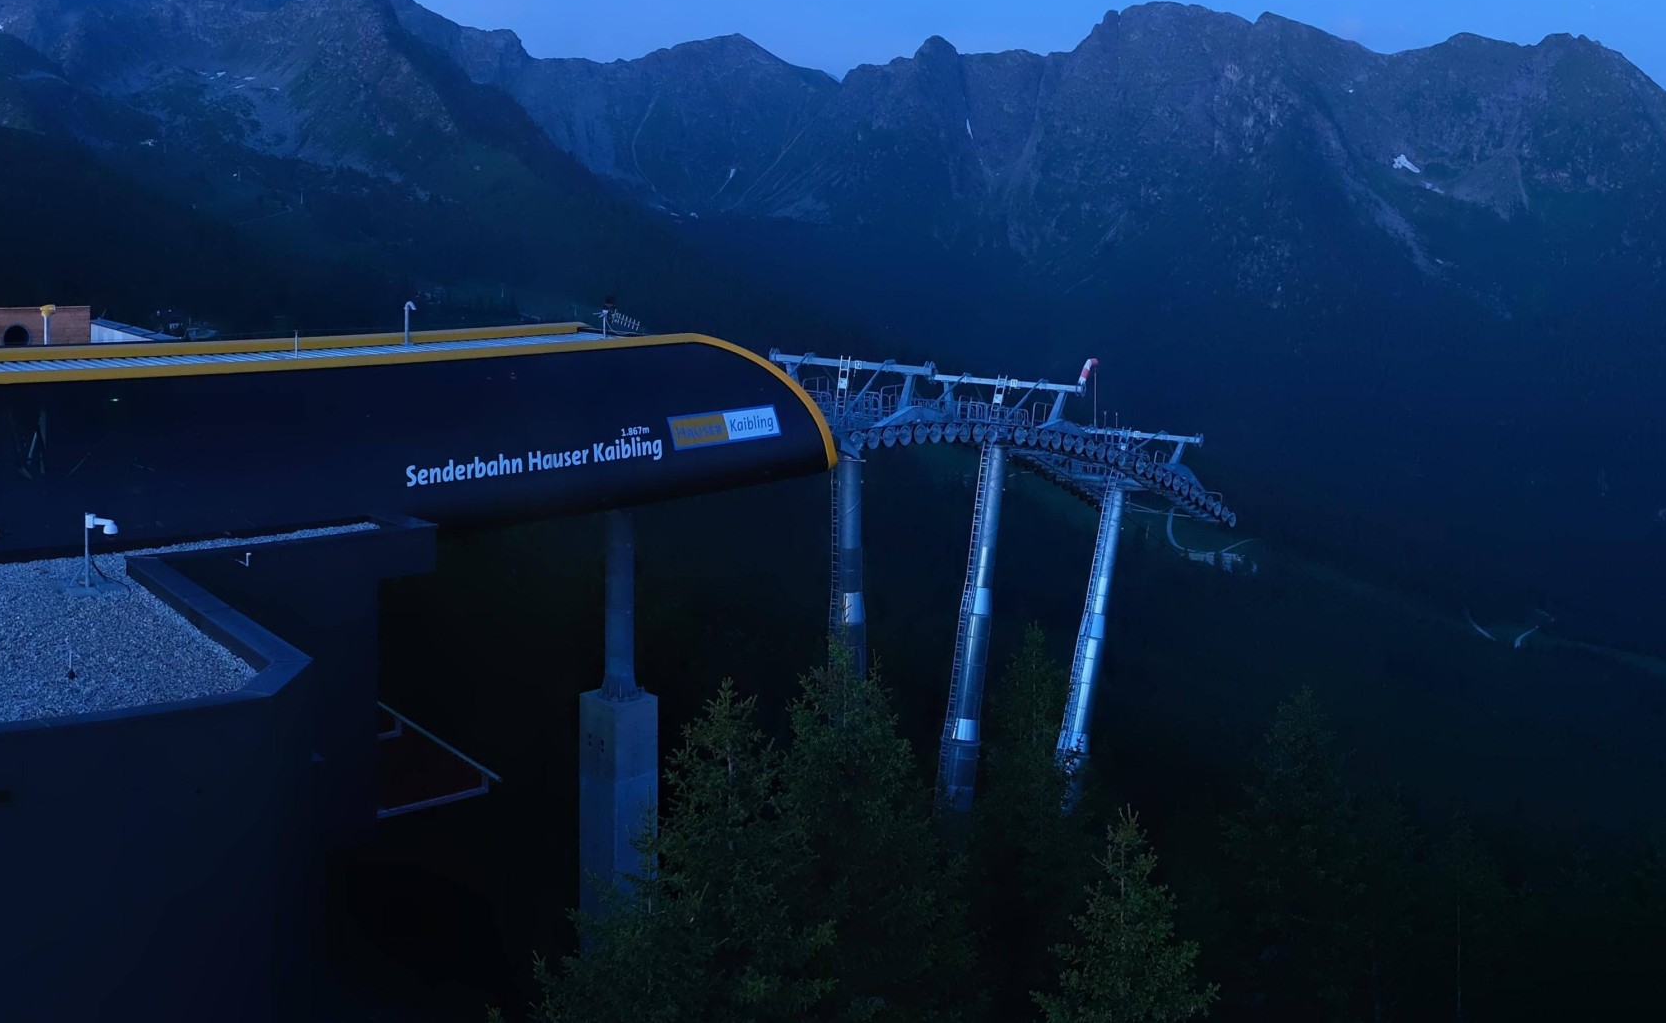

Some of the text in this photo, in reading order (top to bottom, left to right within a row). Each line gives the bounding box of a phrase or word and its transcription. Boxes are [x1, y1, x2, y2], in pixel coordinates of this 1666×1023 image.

[621, 425, 650, 437] 1.867m
[729, 414, 774, 432] Kaibling
[405, 436, 663, 488] Senderbahn Hauser Kaibling
